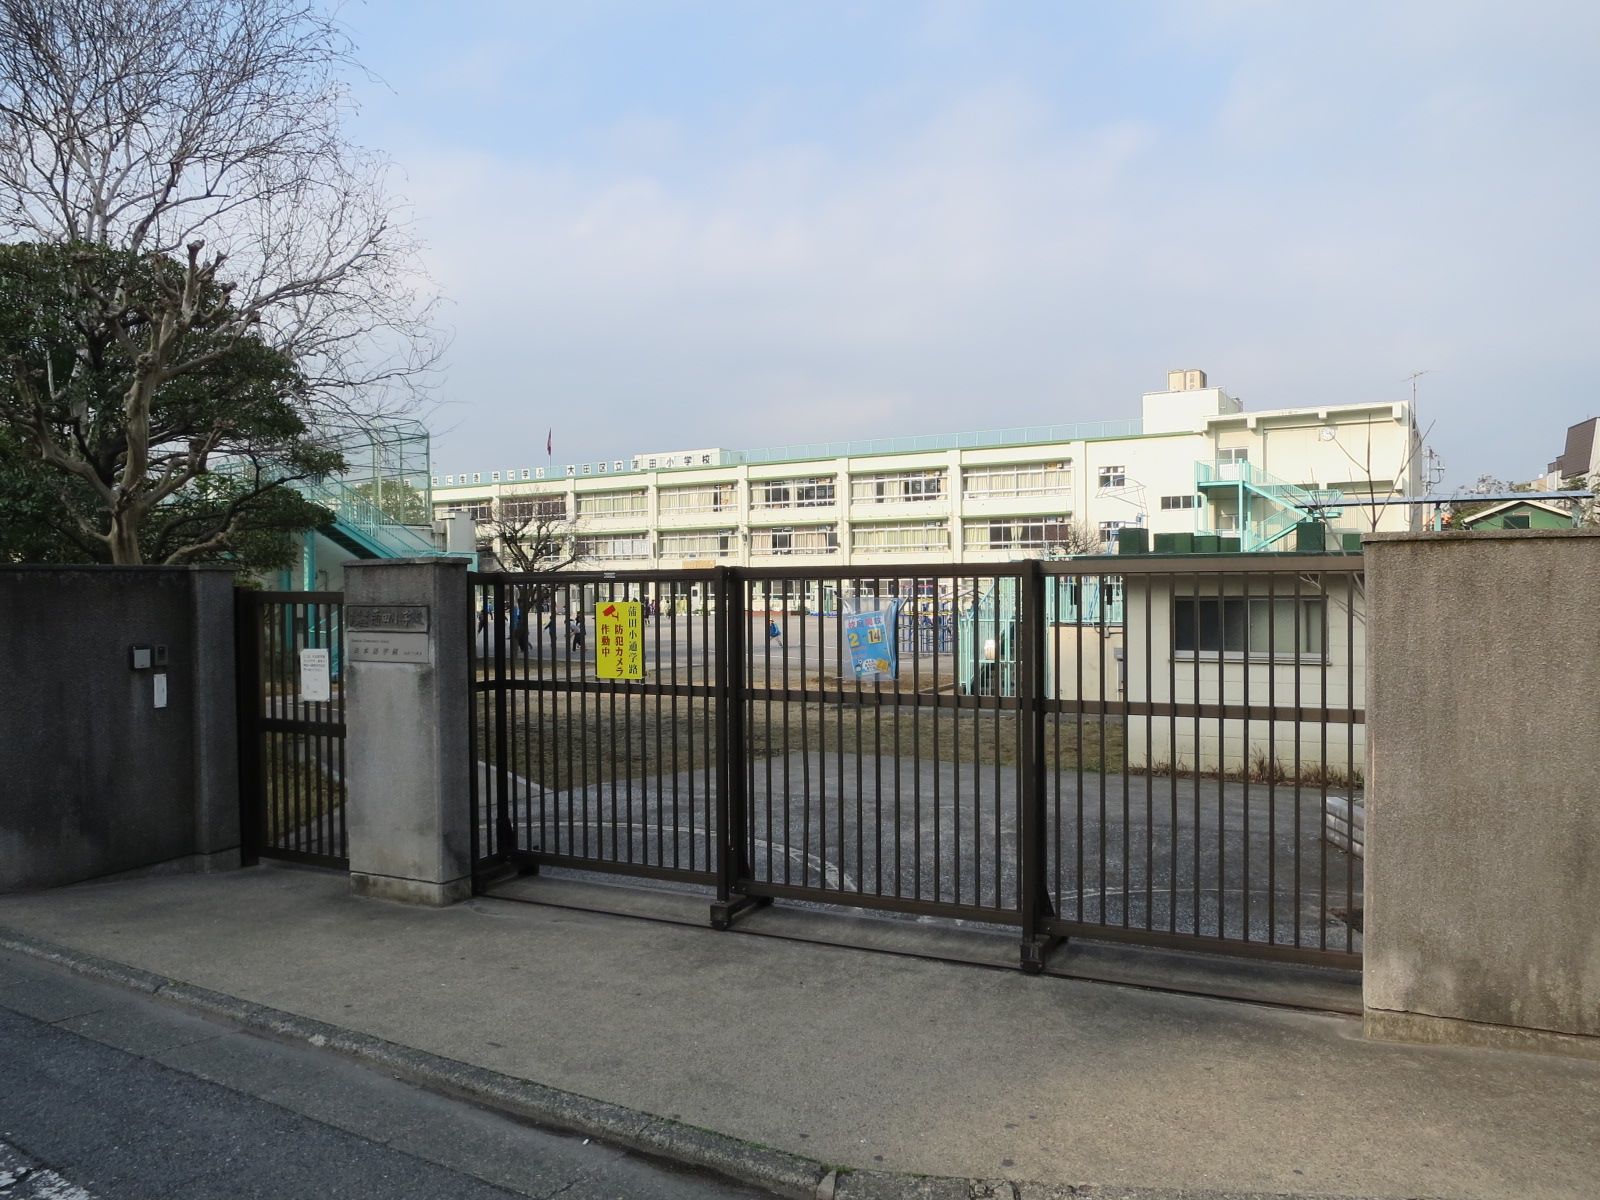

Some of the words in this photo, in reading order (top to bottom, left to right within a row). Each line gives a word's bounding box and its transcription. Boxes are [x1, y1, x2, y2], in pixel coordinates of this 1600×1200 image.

[601, 623, 610, 658] 作動中
[614, 623, 624, 678] 防犯カメラ
[628, 606, 638, 675] 蒲田小通学路
[849, 633, 860, 647] 2
